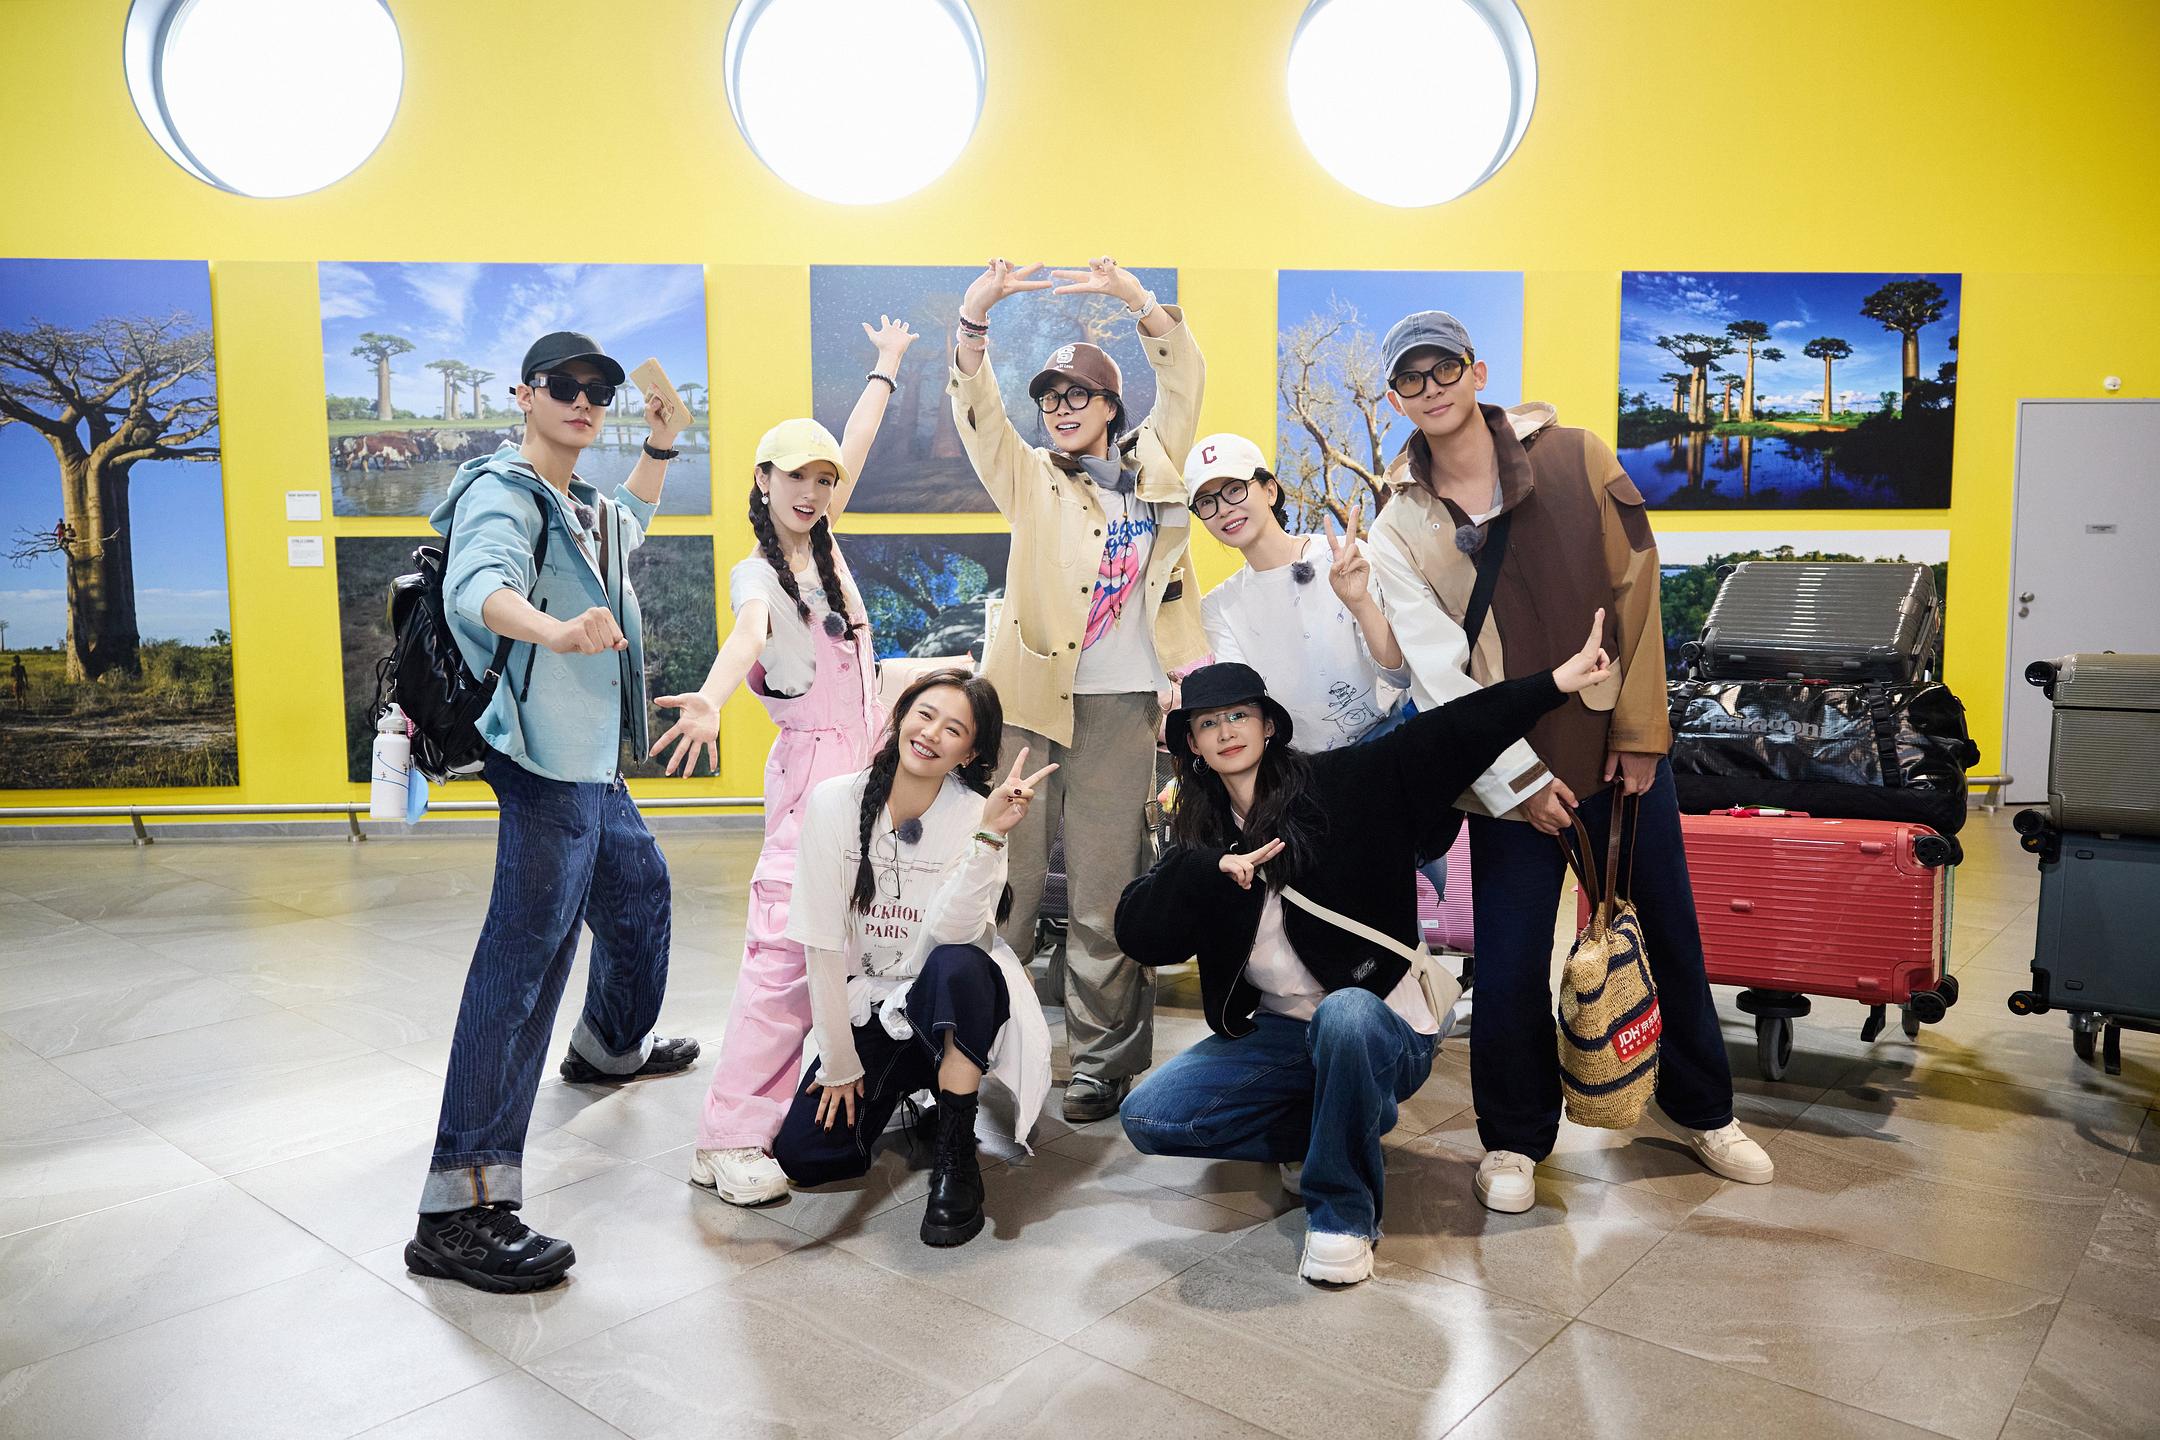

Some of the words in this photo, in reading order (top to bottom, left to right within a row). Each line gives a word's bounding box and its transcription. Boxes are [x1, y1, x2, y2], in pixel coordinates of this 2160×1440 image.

[1056, 345, 1077, 364] S
[1202, 445, 1218, 465] C
[864, 922, 909, 940] PARIS
